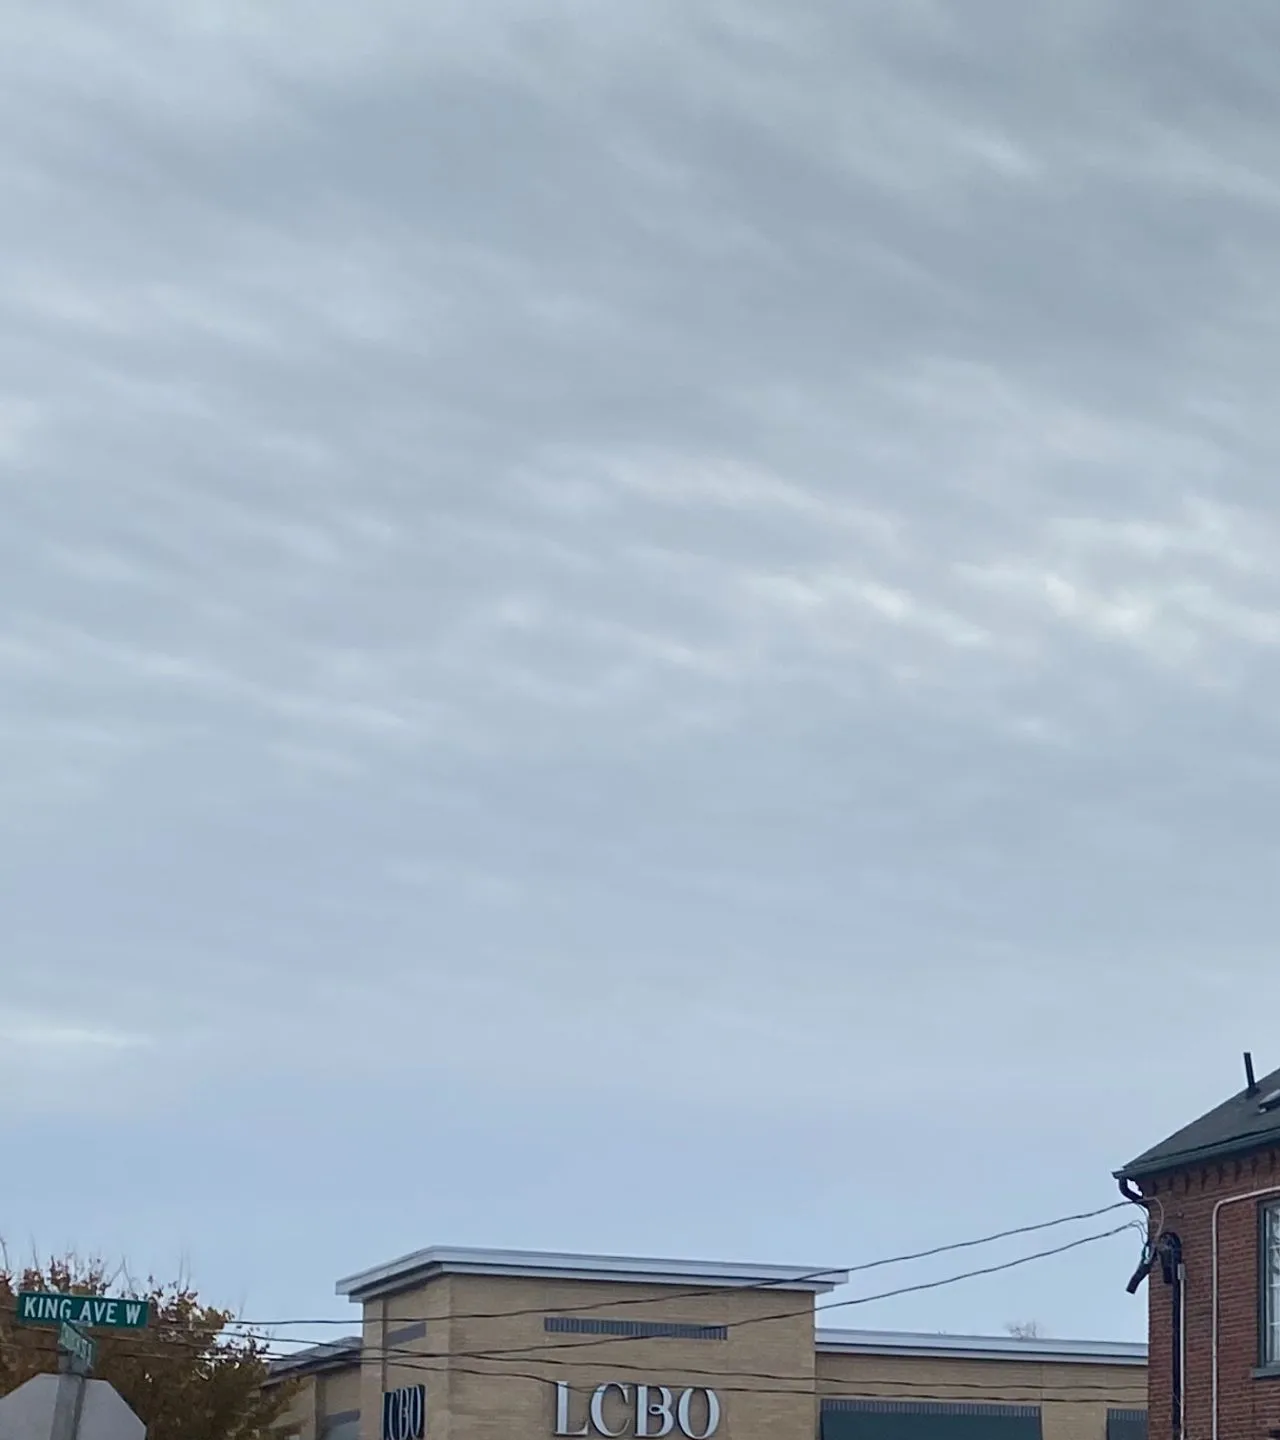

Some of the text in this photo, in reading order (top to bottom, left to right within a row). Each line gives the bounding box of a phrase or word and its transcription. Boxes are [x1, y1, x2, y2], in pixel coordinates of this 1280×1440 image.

[24, 1296, 141, 1325] KING AVE W
[553, 1380, 721, 1440] LCBO
